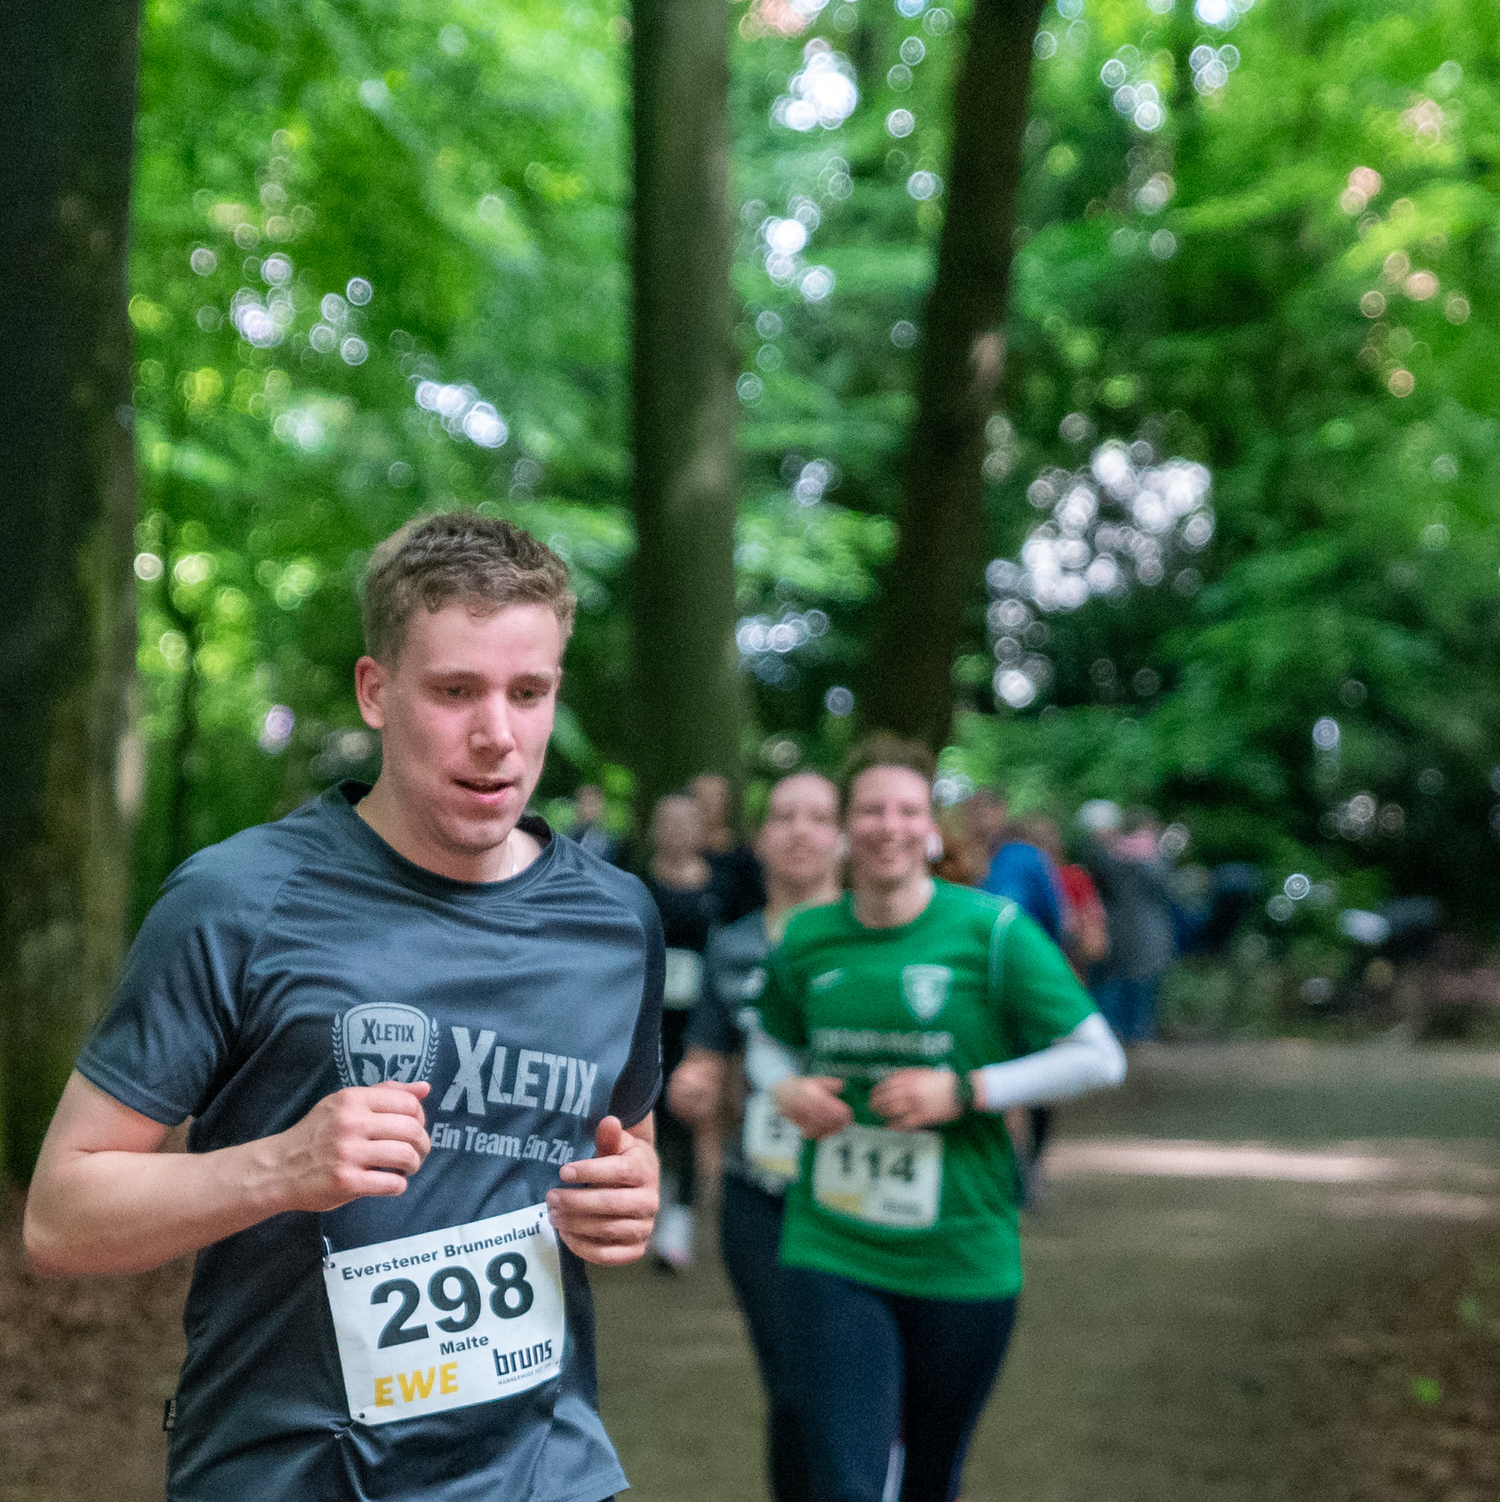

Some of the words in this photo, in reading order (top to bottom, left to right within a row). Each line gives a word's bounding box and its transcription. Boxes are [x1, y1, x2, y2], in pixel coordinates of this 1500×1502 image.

[361, 1018, 415, 1045] XLETIX
[439, 1025, 599, 1118] XLETIX
[430, 1122, 461, 1150] Ein
[464, 1125, 521, 1160] Team,
[522, 1134, 548, 1162] Ein
[835, 1143, 918, 1183] 114
[341, 1250, 439, 1281] Everstener
[443, 1221, 541, 1258] Brunnenlauf
[370, 1251, 534, 1349] 298
[439, 1335, 489, 1355] Malte
[492, 1339, 552, 1377] bruns
[373, 1361, 459, 1408] EWE
